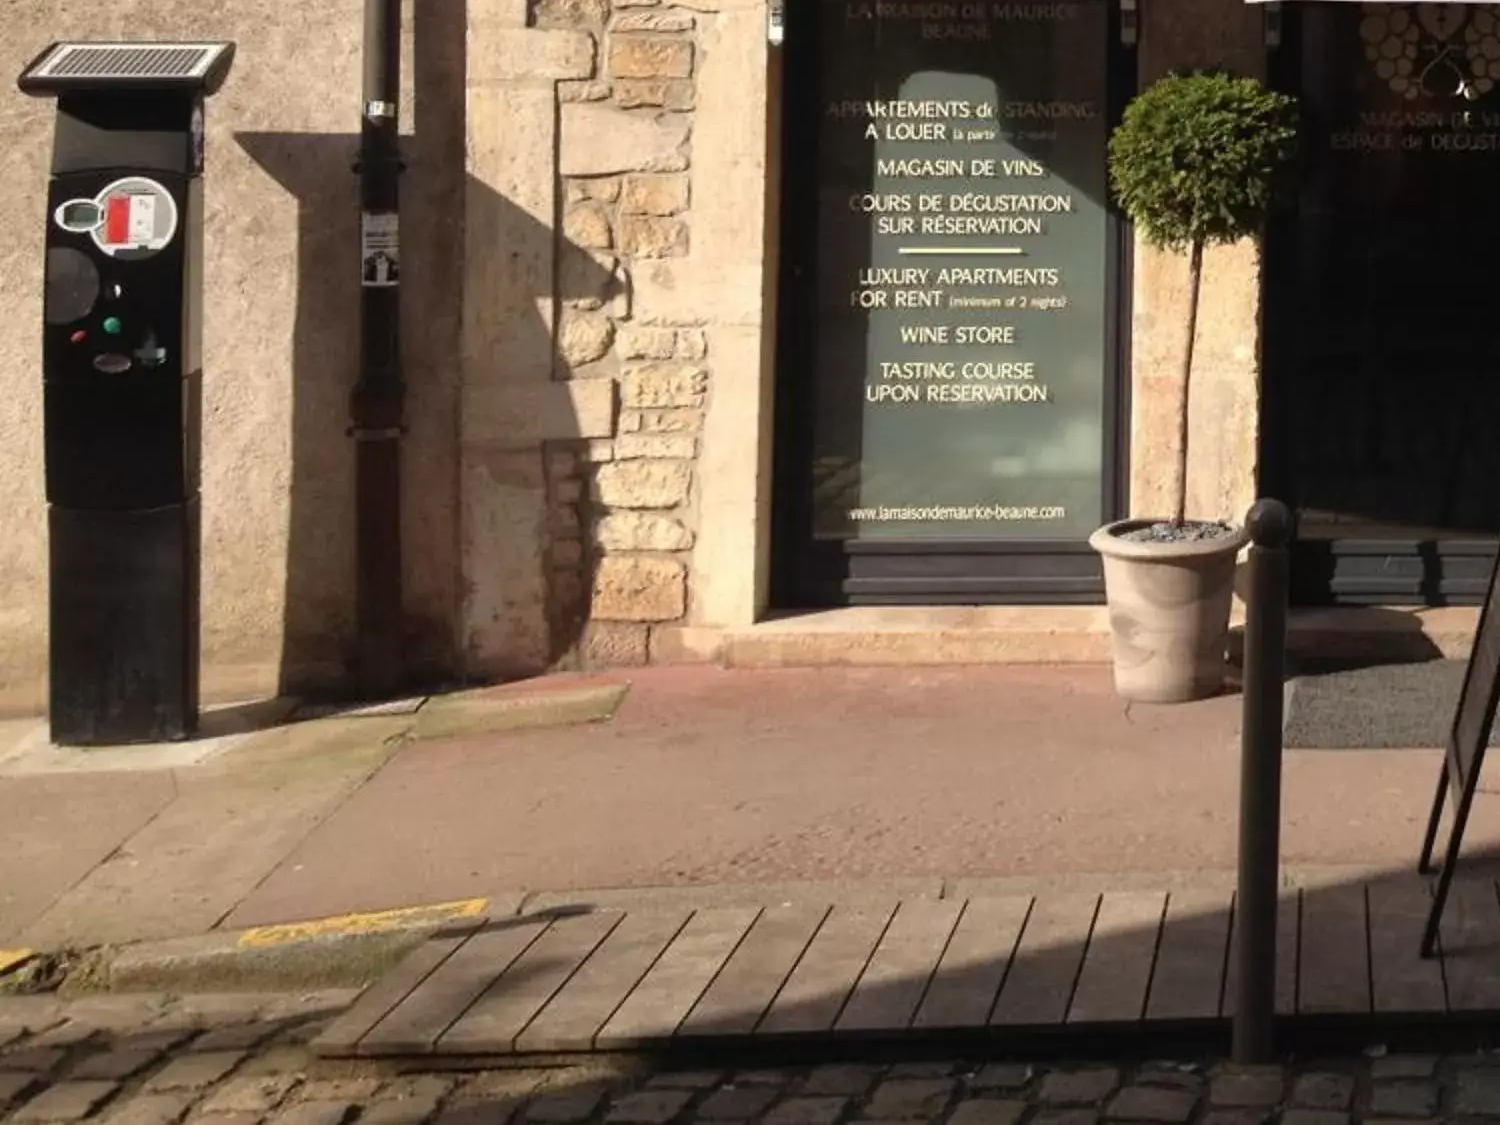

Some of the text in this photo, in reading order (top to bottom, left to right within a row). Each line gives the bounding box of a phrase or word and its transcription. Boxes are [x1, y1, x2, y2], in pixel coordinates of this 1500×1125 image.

[885, 124, 947, 141] LOUER
[1330, 132, 1394, 151] ESPACE
[876, 158, 1044, 177] MAGASIN DE VINS
[849, 193, 912, 212] COURS
[917, 193, 942, 212] DE
[878, 216, 914, 234] SUR
[859, 267, 1059, 286] LUXURY APARTMENTS
[851, 290, 887, 308] FOR
[894, 290, 943, 308] RENT
[900, 326, 1015, 344] WINE STORE
[880, 362, 1035, 380] TASTING COURSE
[866, 384, 1048, 402] UPON RESERVATION
